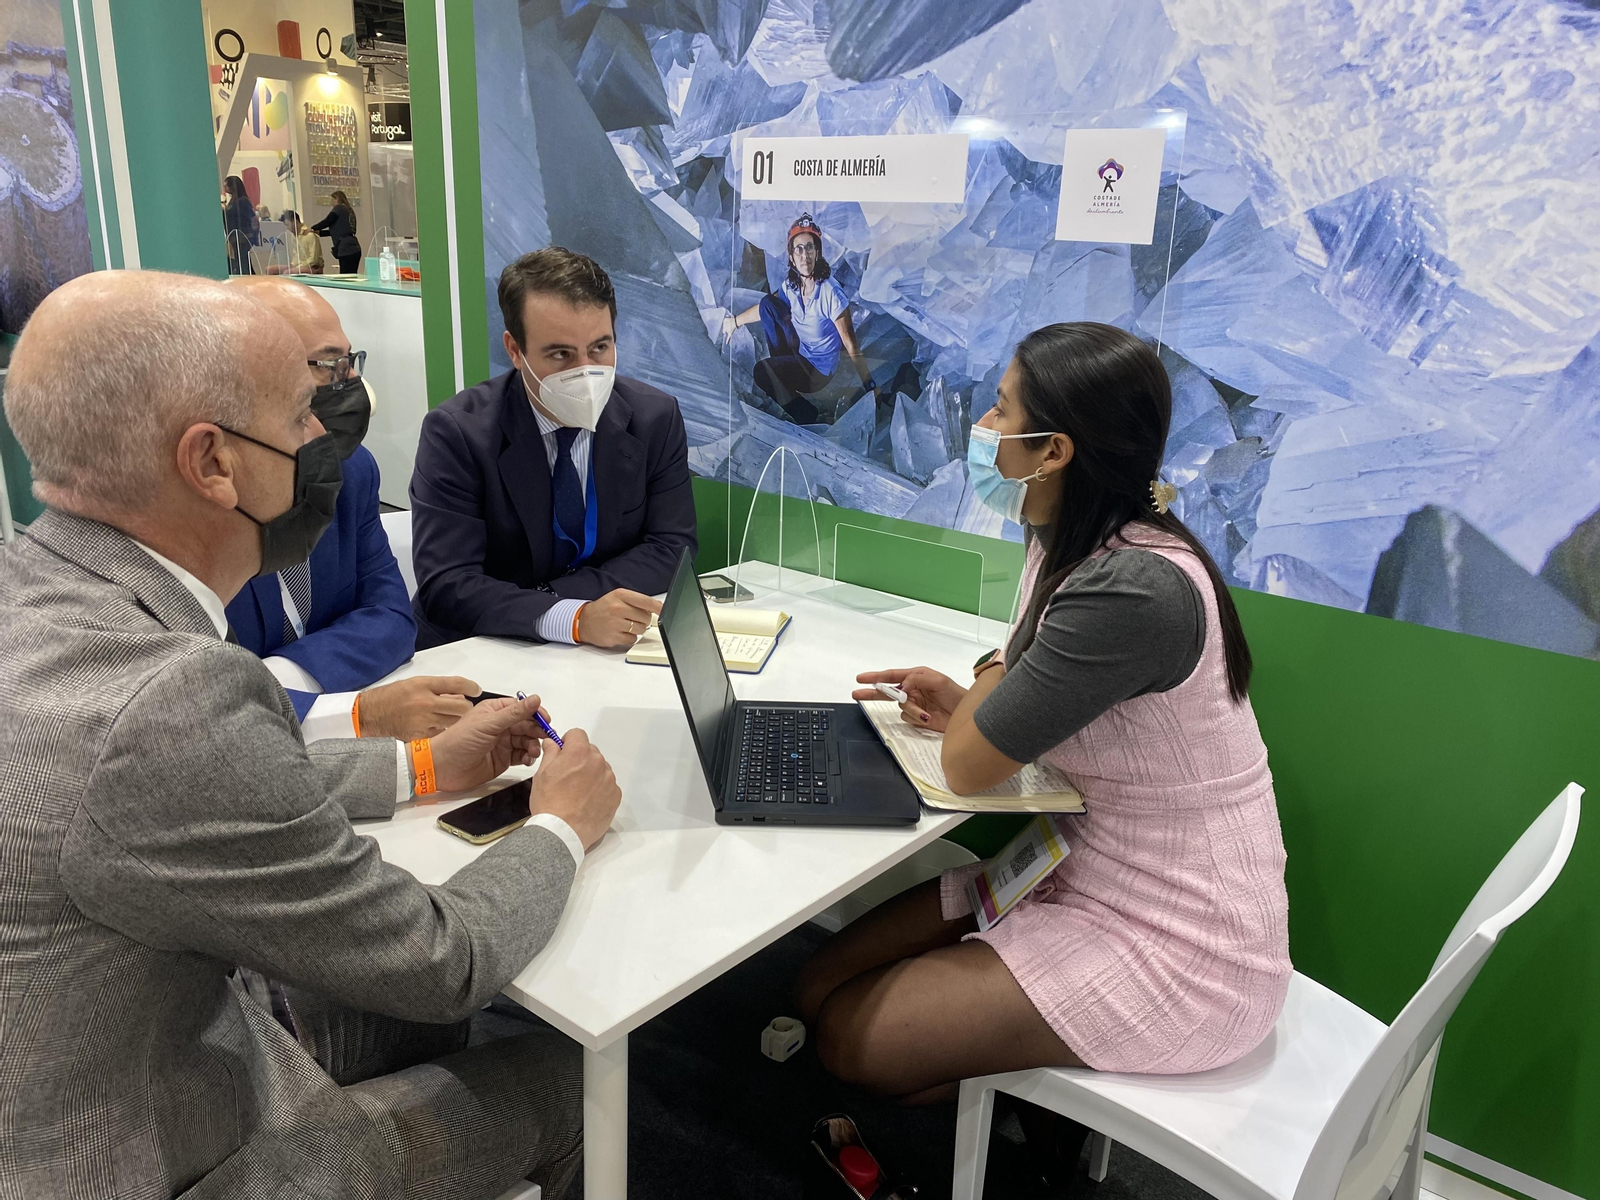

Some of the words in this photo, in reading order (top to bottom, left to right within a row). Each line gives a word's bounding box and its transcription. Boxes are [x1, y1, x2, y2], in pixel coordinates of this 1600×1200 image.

[752, 150, 774, 185] 01
[793, 159, 823, 176] COSTA
[826, 159, 838, 176] DE
[840, 154, 886, 176] ALMERÍA
